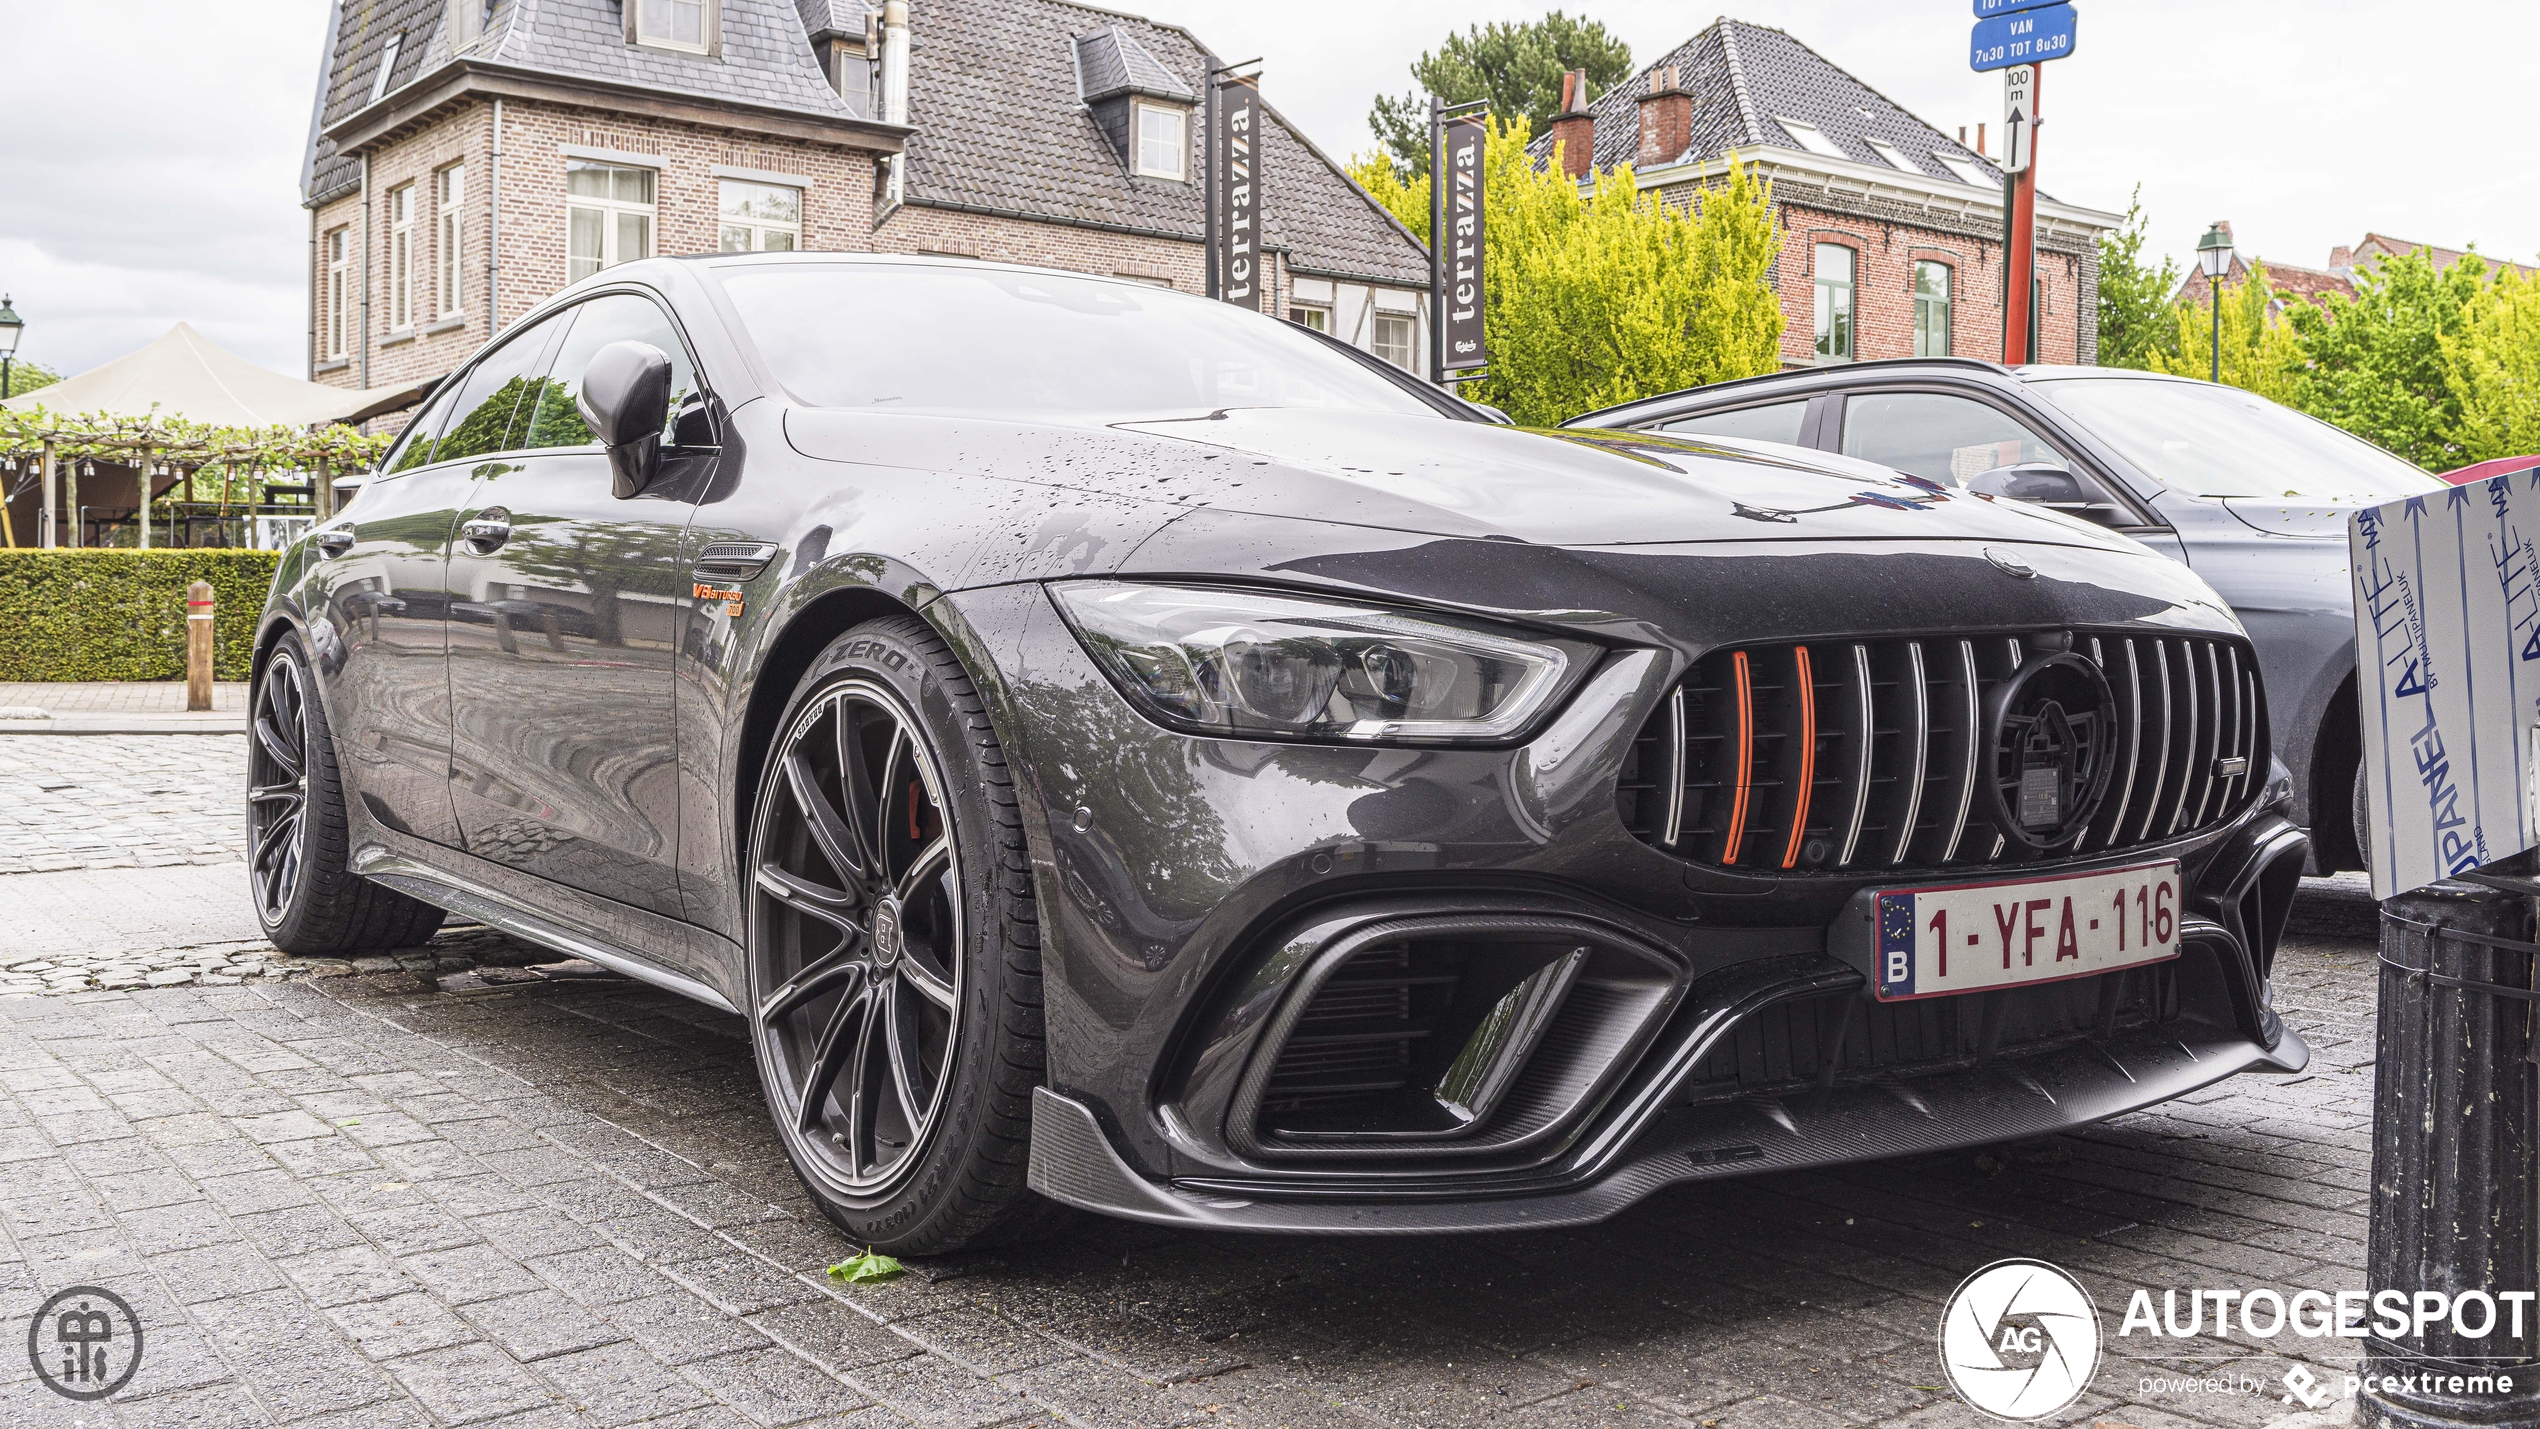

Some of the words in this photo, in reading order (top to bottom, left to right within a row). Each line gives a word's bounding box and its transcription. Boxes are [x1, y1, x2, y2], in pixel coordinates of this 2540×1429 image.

[2010, 19, 2033, 36] VAN
[1975, 46, 2004, 64] 7u30
[2010, 40, 2031, 57] TOT
[2036, 34, 2067, 53] 8u30
[2007, 70, 2028, 87] 100
[2010, 89, 2023, 101] m
[2396, 570, 2431, 667] MULTIPANELUK
[831, 640, 908, 673] ZERO
[2427, 671, 2438, 690] BY
[1887, 951, 1909, 984] B
